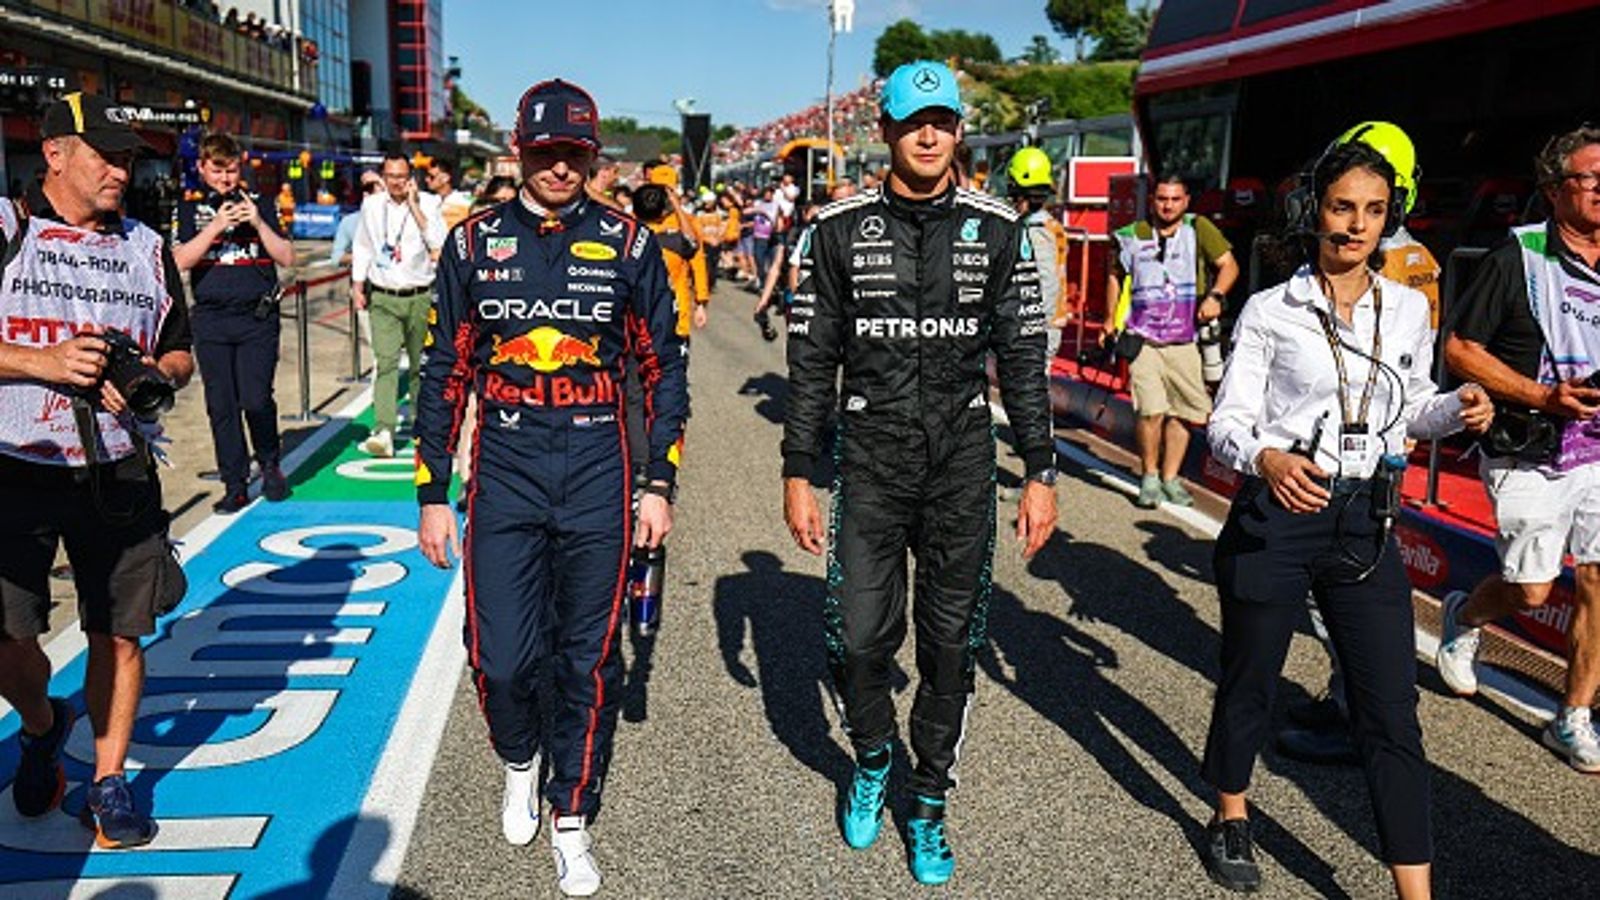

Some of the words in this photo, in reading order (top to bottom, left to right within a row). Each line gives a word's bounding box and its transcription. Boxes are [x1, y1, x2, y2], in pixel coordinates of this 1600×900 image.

[533, 103, 546, 122] 1
[11, 278, 155, 311] PHOTOGRAPHER
[478, 299, 614, 322] ORACLE
[856, 317, 979, 338] PETRONAS
[484, 371, 545, 406] Red
[551, 371, 615, 407] Bull
